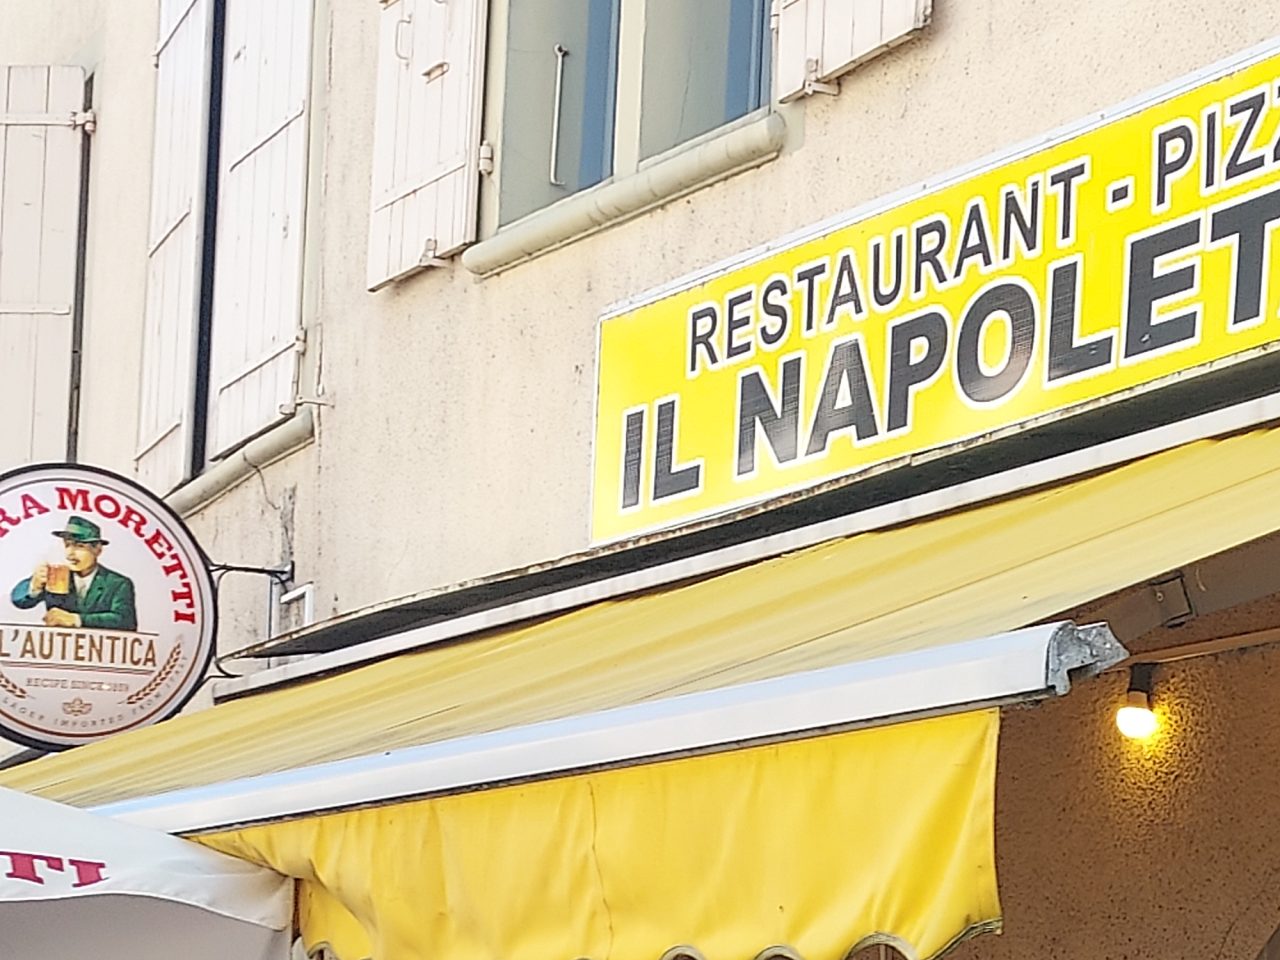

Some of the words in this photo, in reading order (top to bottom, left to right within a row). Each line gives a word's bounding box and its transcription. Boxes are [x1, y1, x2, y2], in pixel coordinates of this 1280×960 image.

[690, 163, 1086, 372] RESTAURANT
[621, 400, 702, 510] IL
[55, 487, 197, 625] MORETTI
[0, 628, 157, 667] L'AUTENTICA
